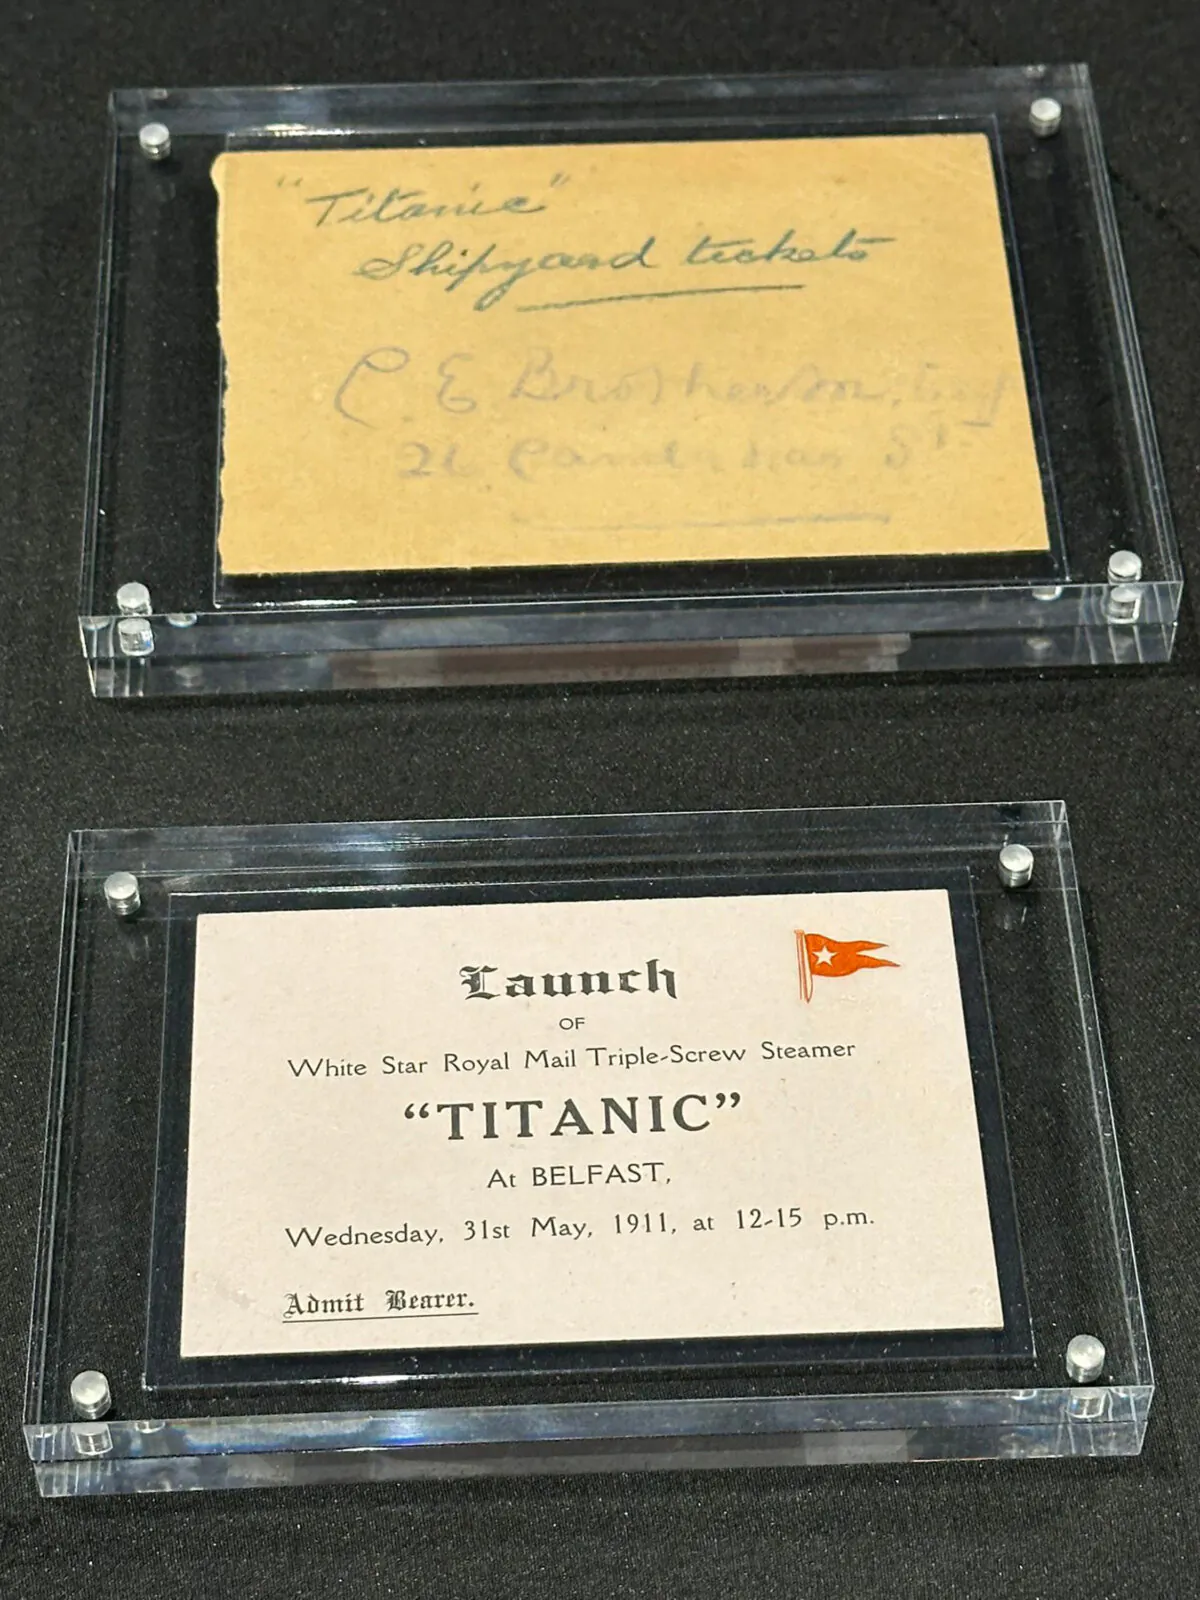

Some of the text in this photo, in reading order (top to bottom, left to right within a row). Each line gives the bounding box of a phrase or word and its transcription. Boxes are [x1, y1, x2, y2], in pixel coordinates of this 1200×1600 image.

[350, 227, 897, 311] Shipyard tickets
[458, 958, 678, 1001] Launch
[558, 1016, 586, 1031] OF
[287, 1040, 856, 1078] White Star Royal Mail Triple-Screw Steamer
[403, 1091, 741, 1141] “TITANIC”
[486, 1161, 671, 1189] At BELFAST,
[284, 1207, 875, 1248] Wednesday, 31st May, 1911, at 12-15 p.m.
[282, 1289, 476, 1320] Admit Bearer.
